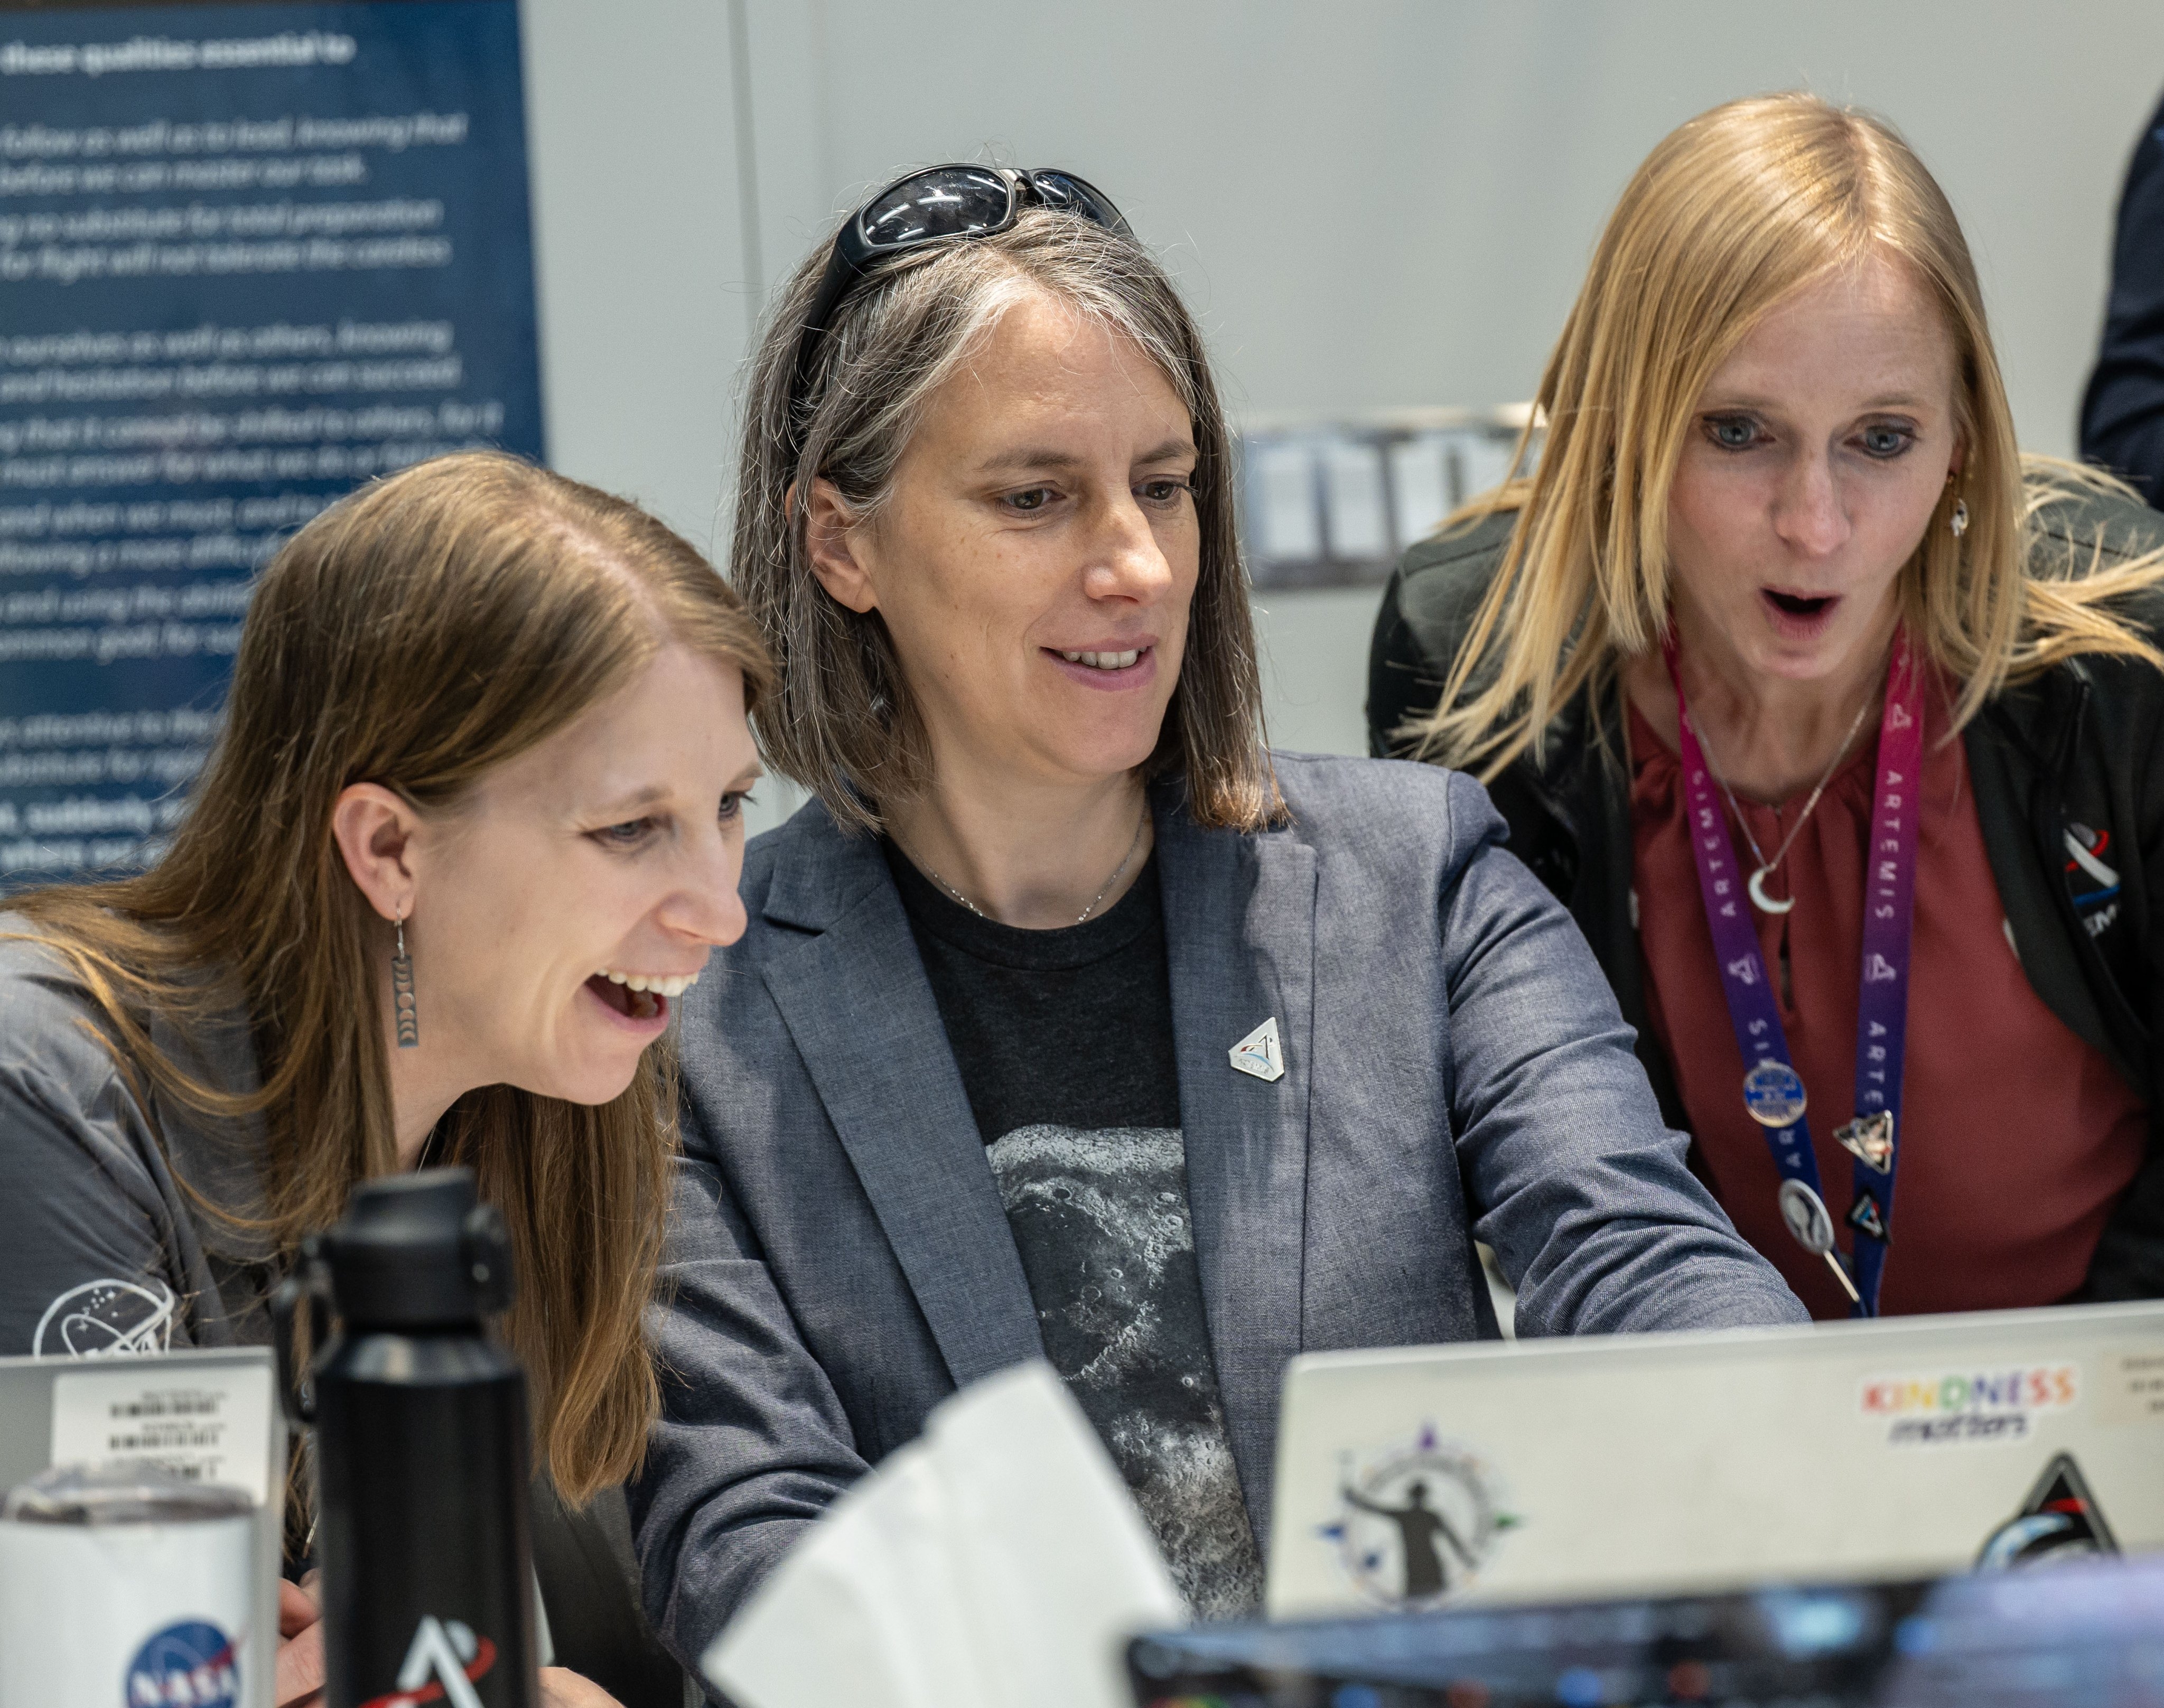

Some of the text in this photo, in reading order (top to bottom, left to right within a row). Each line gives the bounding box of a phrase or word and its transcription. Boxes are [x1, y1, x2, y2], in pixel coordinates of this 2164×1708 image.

[79, 38, 195, 74] qualities
[198, 32, 318, 66] essential
[320, 34, 355, 61] to
[115, 121, 168, 152] well
[299, 116, 408, 151] knowing
[409, 112, 466, 142] that
[61, 208, 185, 239] substitute
[290, 200, 442, 235] preparation
[340, 321, 451, 354] knowing
[1691, 769, 1738, 918] ARTEMIS
[1873, 769, 1904, 920] ARTEMIS
[1863, 1020, 1888, 1106] ARTE
[1863, 1366, 2076, 1413] KINDNESS
[1889, 1412, 2029, 1445] matters
[131, 1665, 237, 1704] NASA
